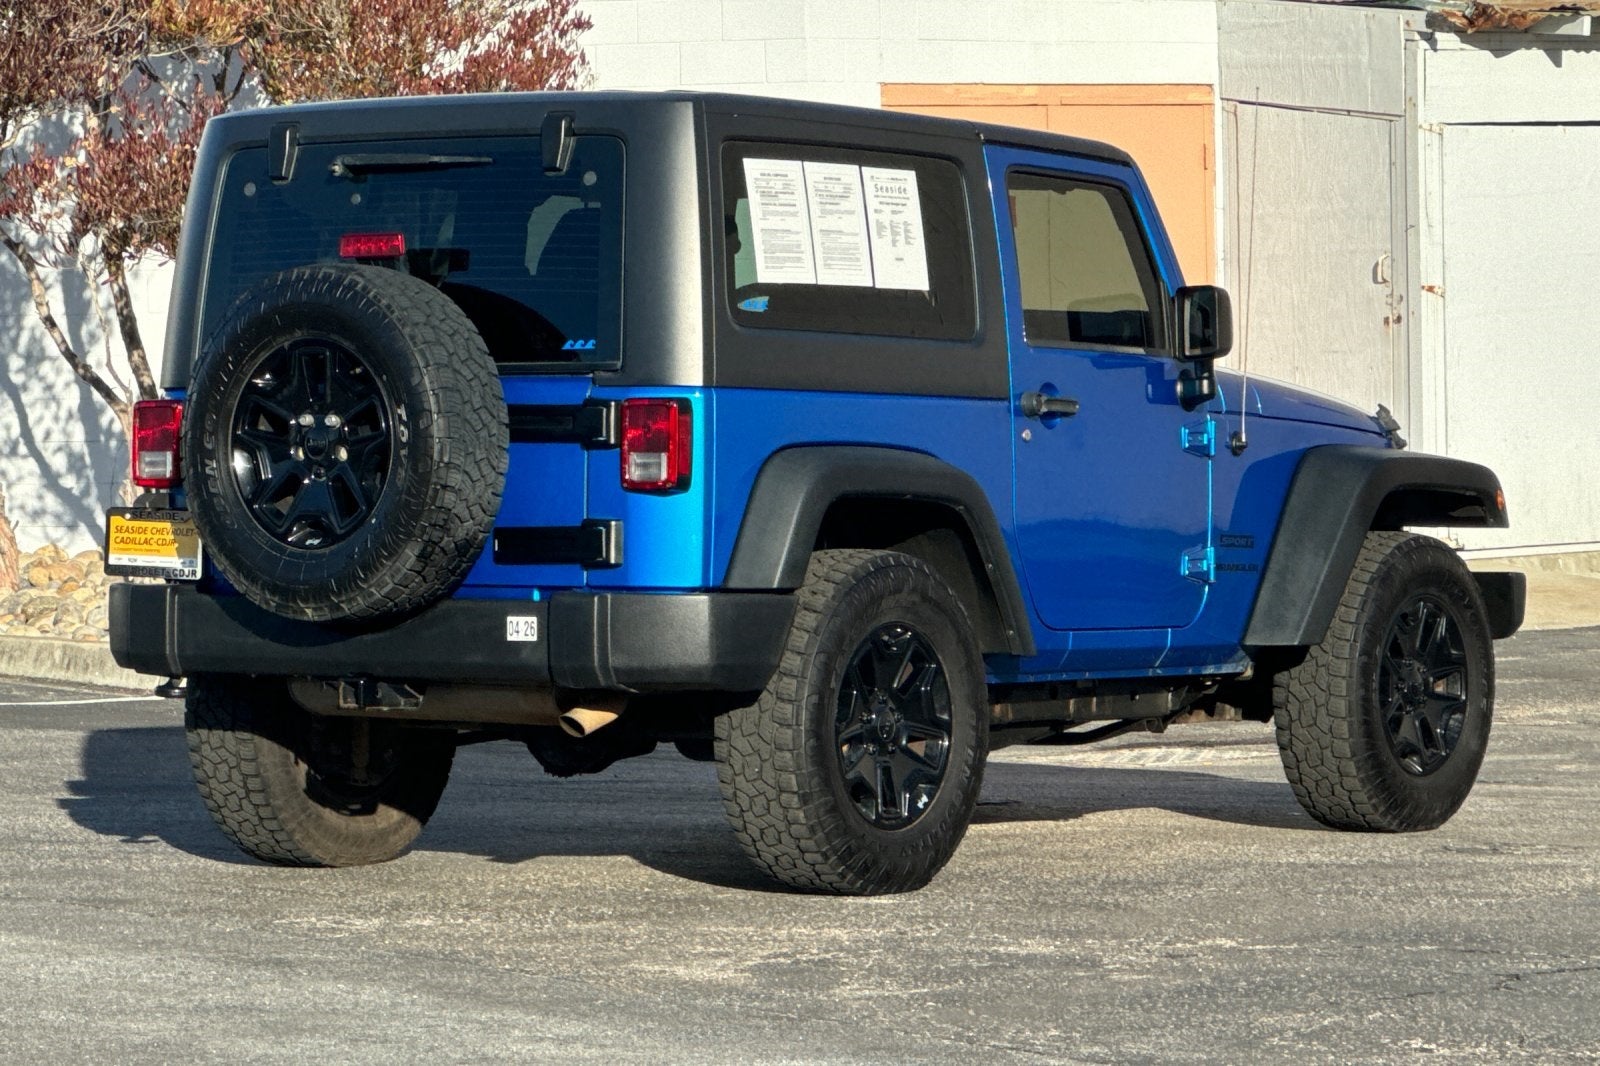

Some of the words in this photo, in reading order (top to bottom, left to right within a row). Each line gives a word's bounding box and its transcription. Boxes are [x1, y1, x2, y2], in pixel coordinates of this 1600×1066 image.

[874, 183, 908, 195] Seaside
[132, 510, 180, 521] SEASIDE
[113, 524, 149, 535] SEASIDE
[113, 536, 177, 547] CADILLAC-CDJR
[171, 568, 198, 579] CDJR
[508, 620, 520, 637] 04
[523, 620, 536, 637] 26
